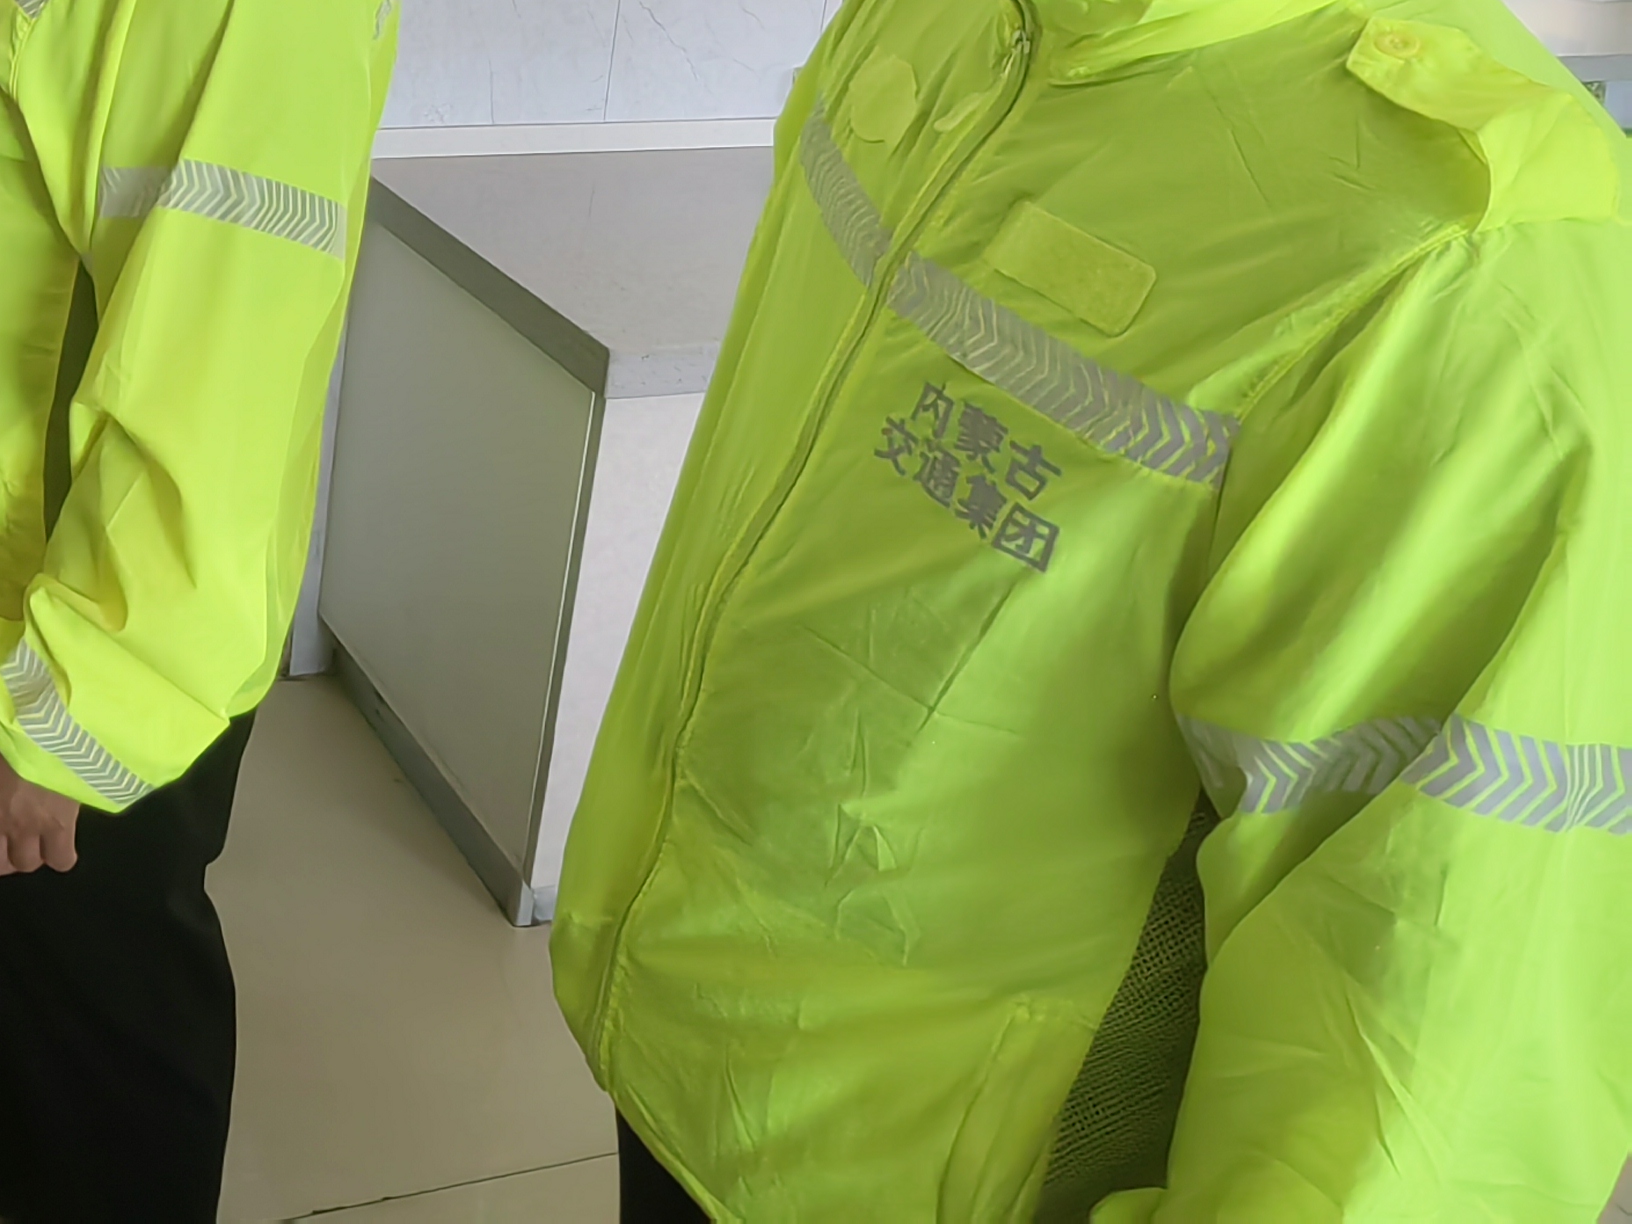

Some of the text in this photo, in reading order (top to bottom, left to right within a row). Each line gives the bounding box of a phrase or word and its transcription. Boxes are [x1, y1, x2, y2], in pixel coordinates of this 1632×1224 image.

[873, 415, 1061, 574] 交通集团
[910, 381, 1063, 501] 内蒙古
